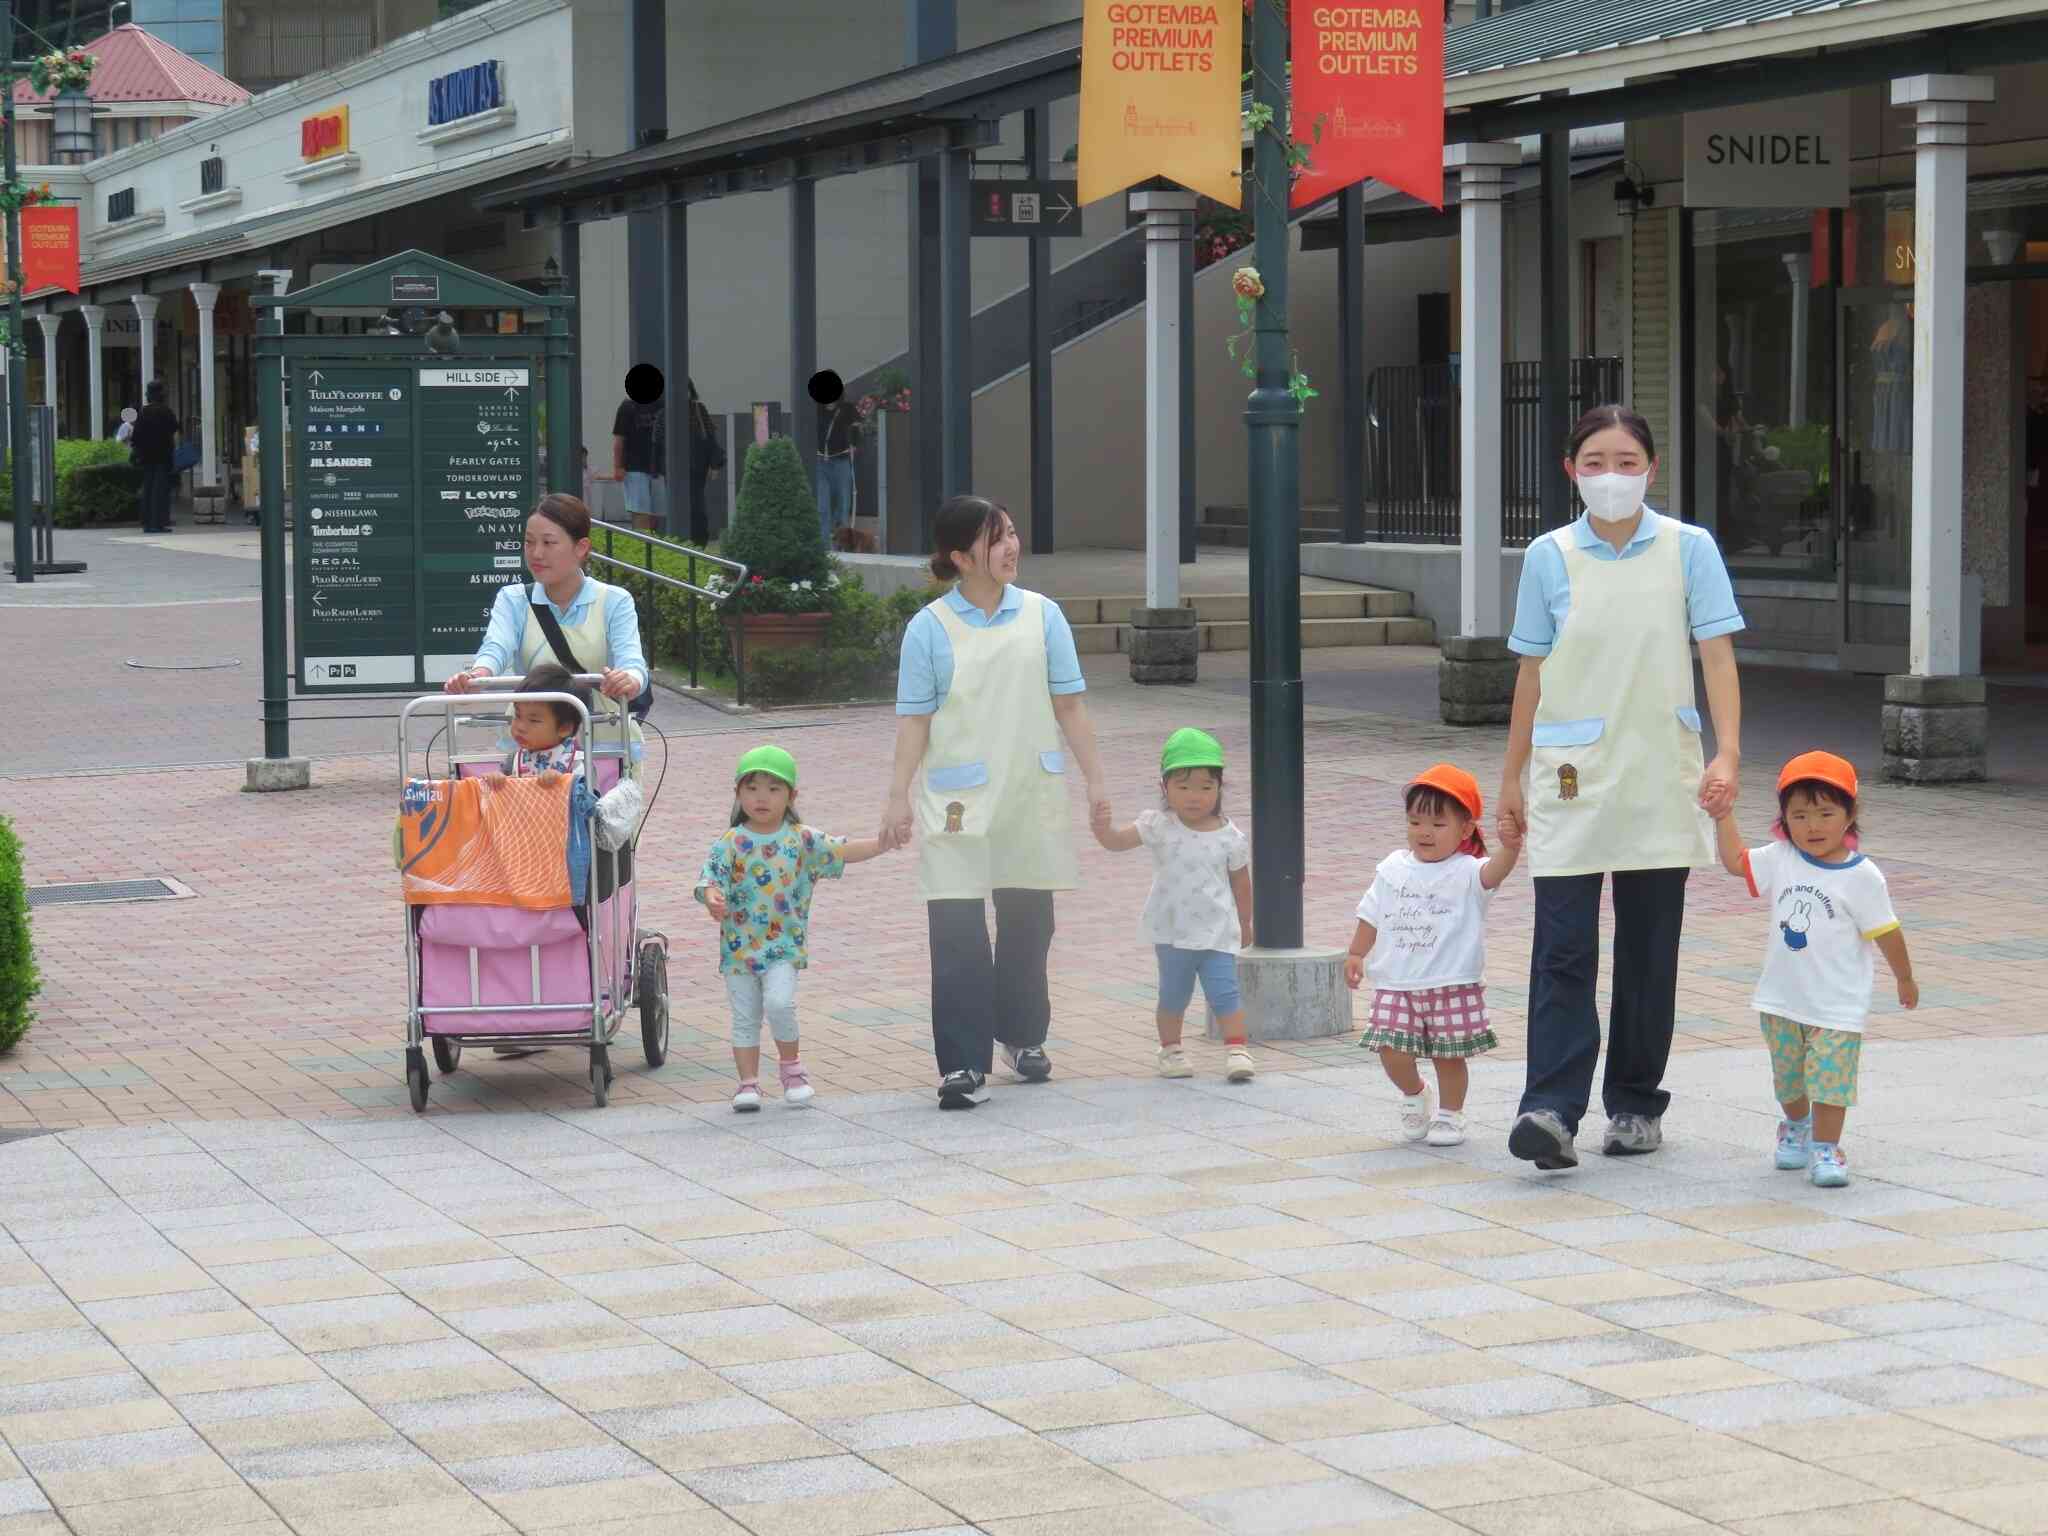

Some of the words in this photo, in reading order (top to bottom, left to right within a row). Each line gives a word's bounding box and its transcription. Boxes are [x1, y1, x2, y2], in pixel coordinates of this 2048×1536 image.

[1107, 4, 1218, 25] GOTEMBA
[1313, 8, 1421, 29] GOTEMBA
[1112, 27, 1213, 49] PREMIUM
[1319, 31, 1417, 52] PREMIUM
[1112, 51, 1213, 73] OUTLETS
[1319, 54, 1418, 75] OUTLETS
[1706, 134, 1831, 164] SNIDEL
[446, 372, 472, 383] HILL
[474, 372, 501, 383] SIDE
[308, 424, 380, 433] MARNI
[326, 457, 372, 468] SANDER
[449, 456, 487, 466] PEARLY
[489, 457, 521, 466] GATES
[324, 509, 378, 518] NISHIKAWA
[311, 524, 360, 537] Timberland
[478, 523, 522, 533] ANAYI
[470, 574, 480, 584] AS
[482, 574, 510, 584] KNOW
[511, 573, 522, 584] AS
[1795, 884, 1814, 894] and
